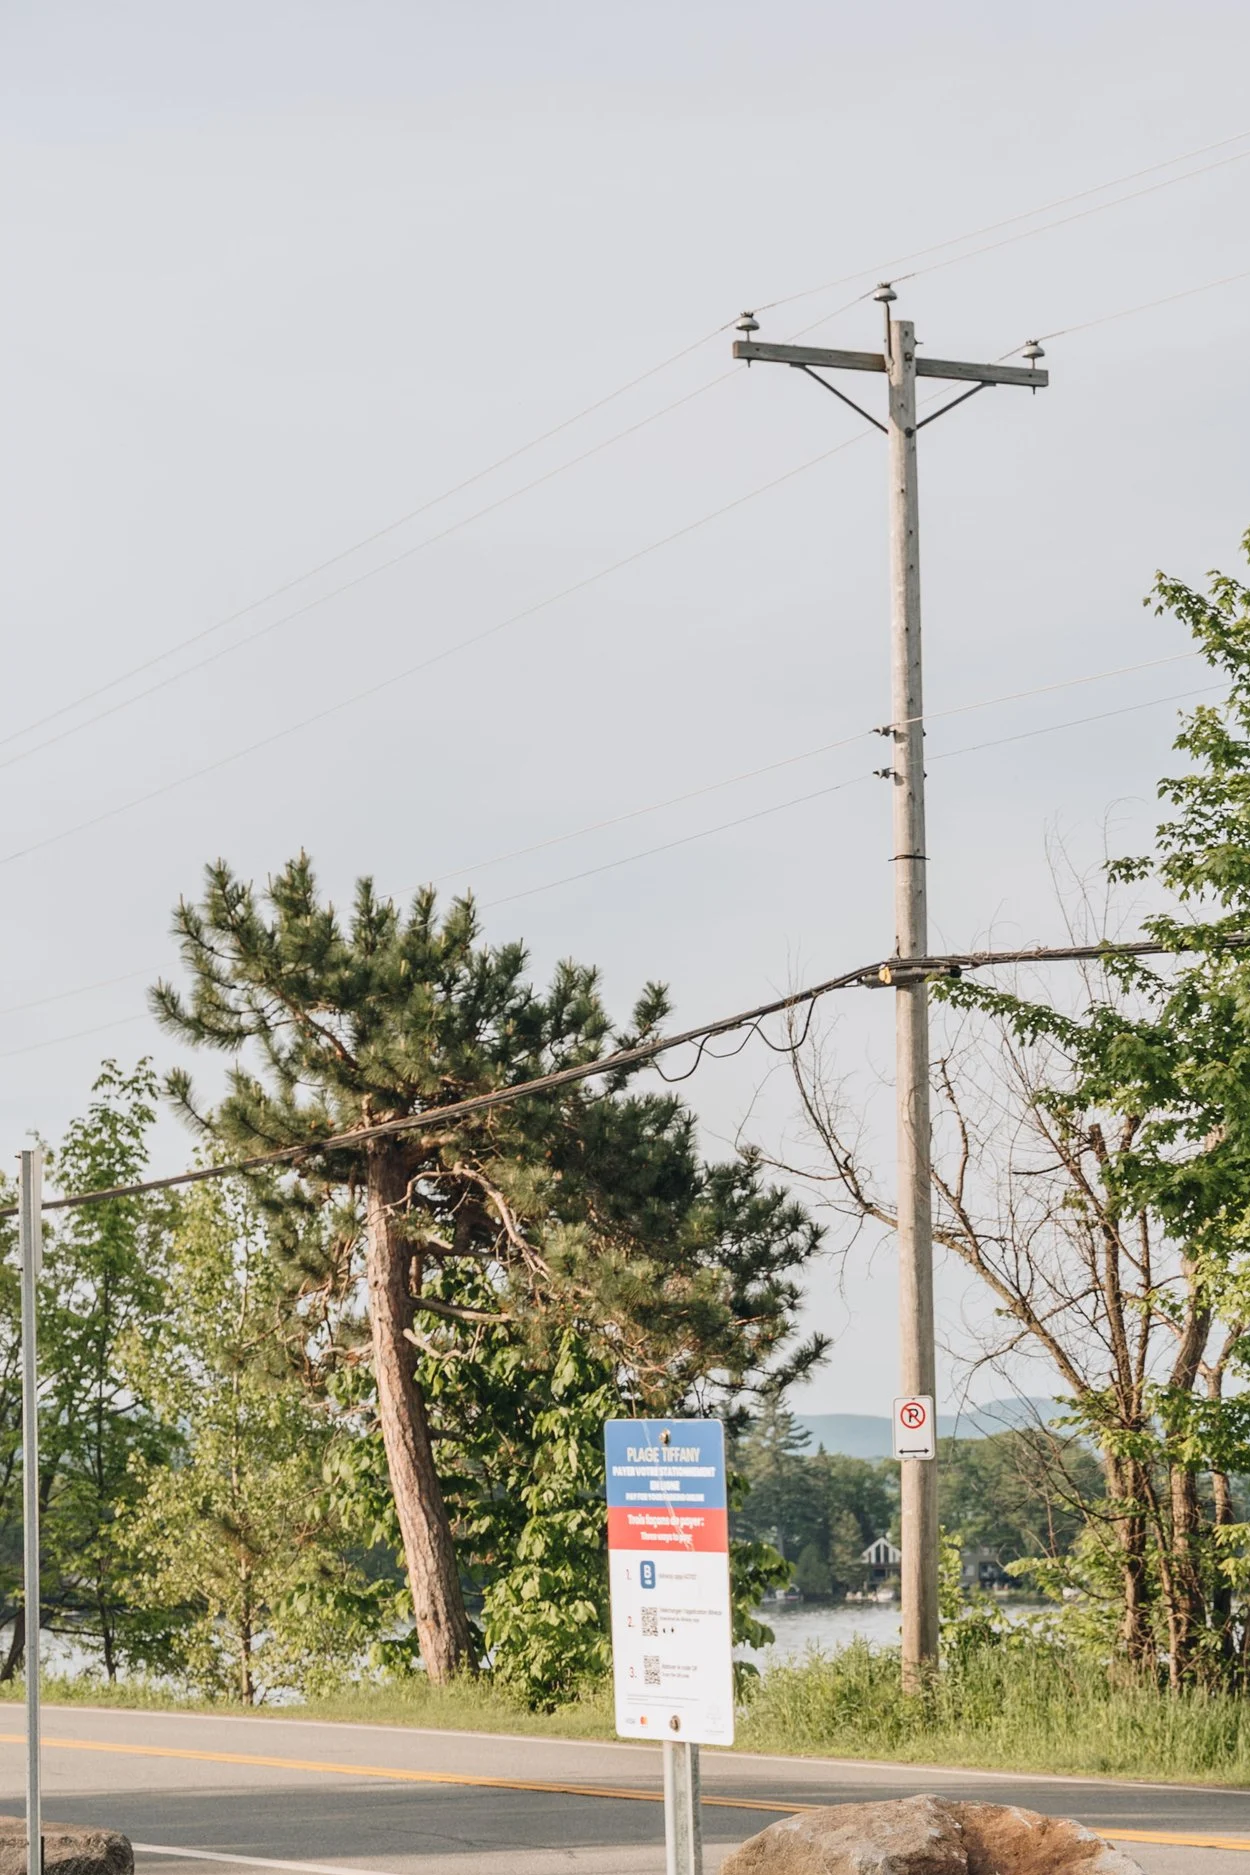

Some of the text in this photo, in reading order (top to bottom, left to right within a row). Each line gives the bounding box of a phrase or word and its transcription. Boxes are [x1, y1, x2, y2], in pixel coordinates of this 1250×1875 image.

[626, 1447, 700, 1463] PLAGE TIFFANY
[612, 1466, 635, 1476] PAYER
[627, 1514, 645, 1525] Trois
